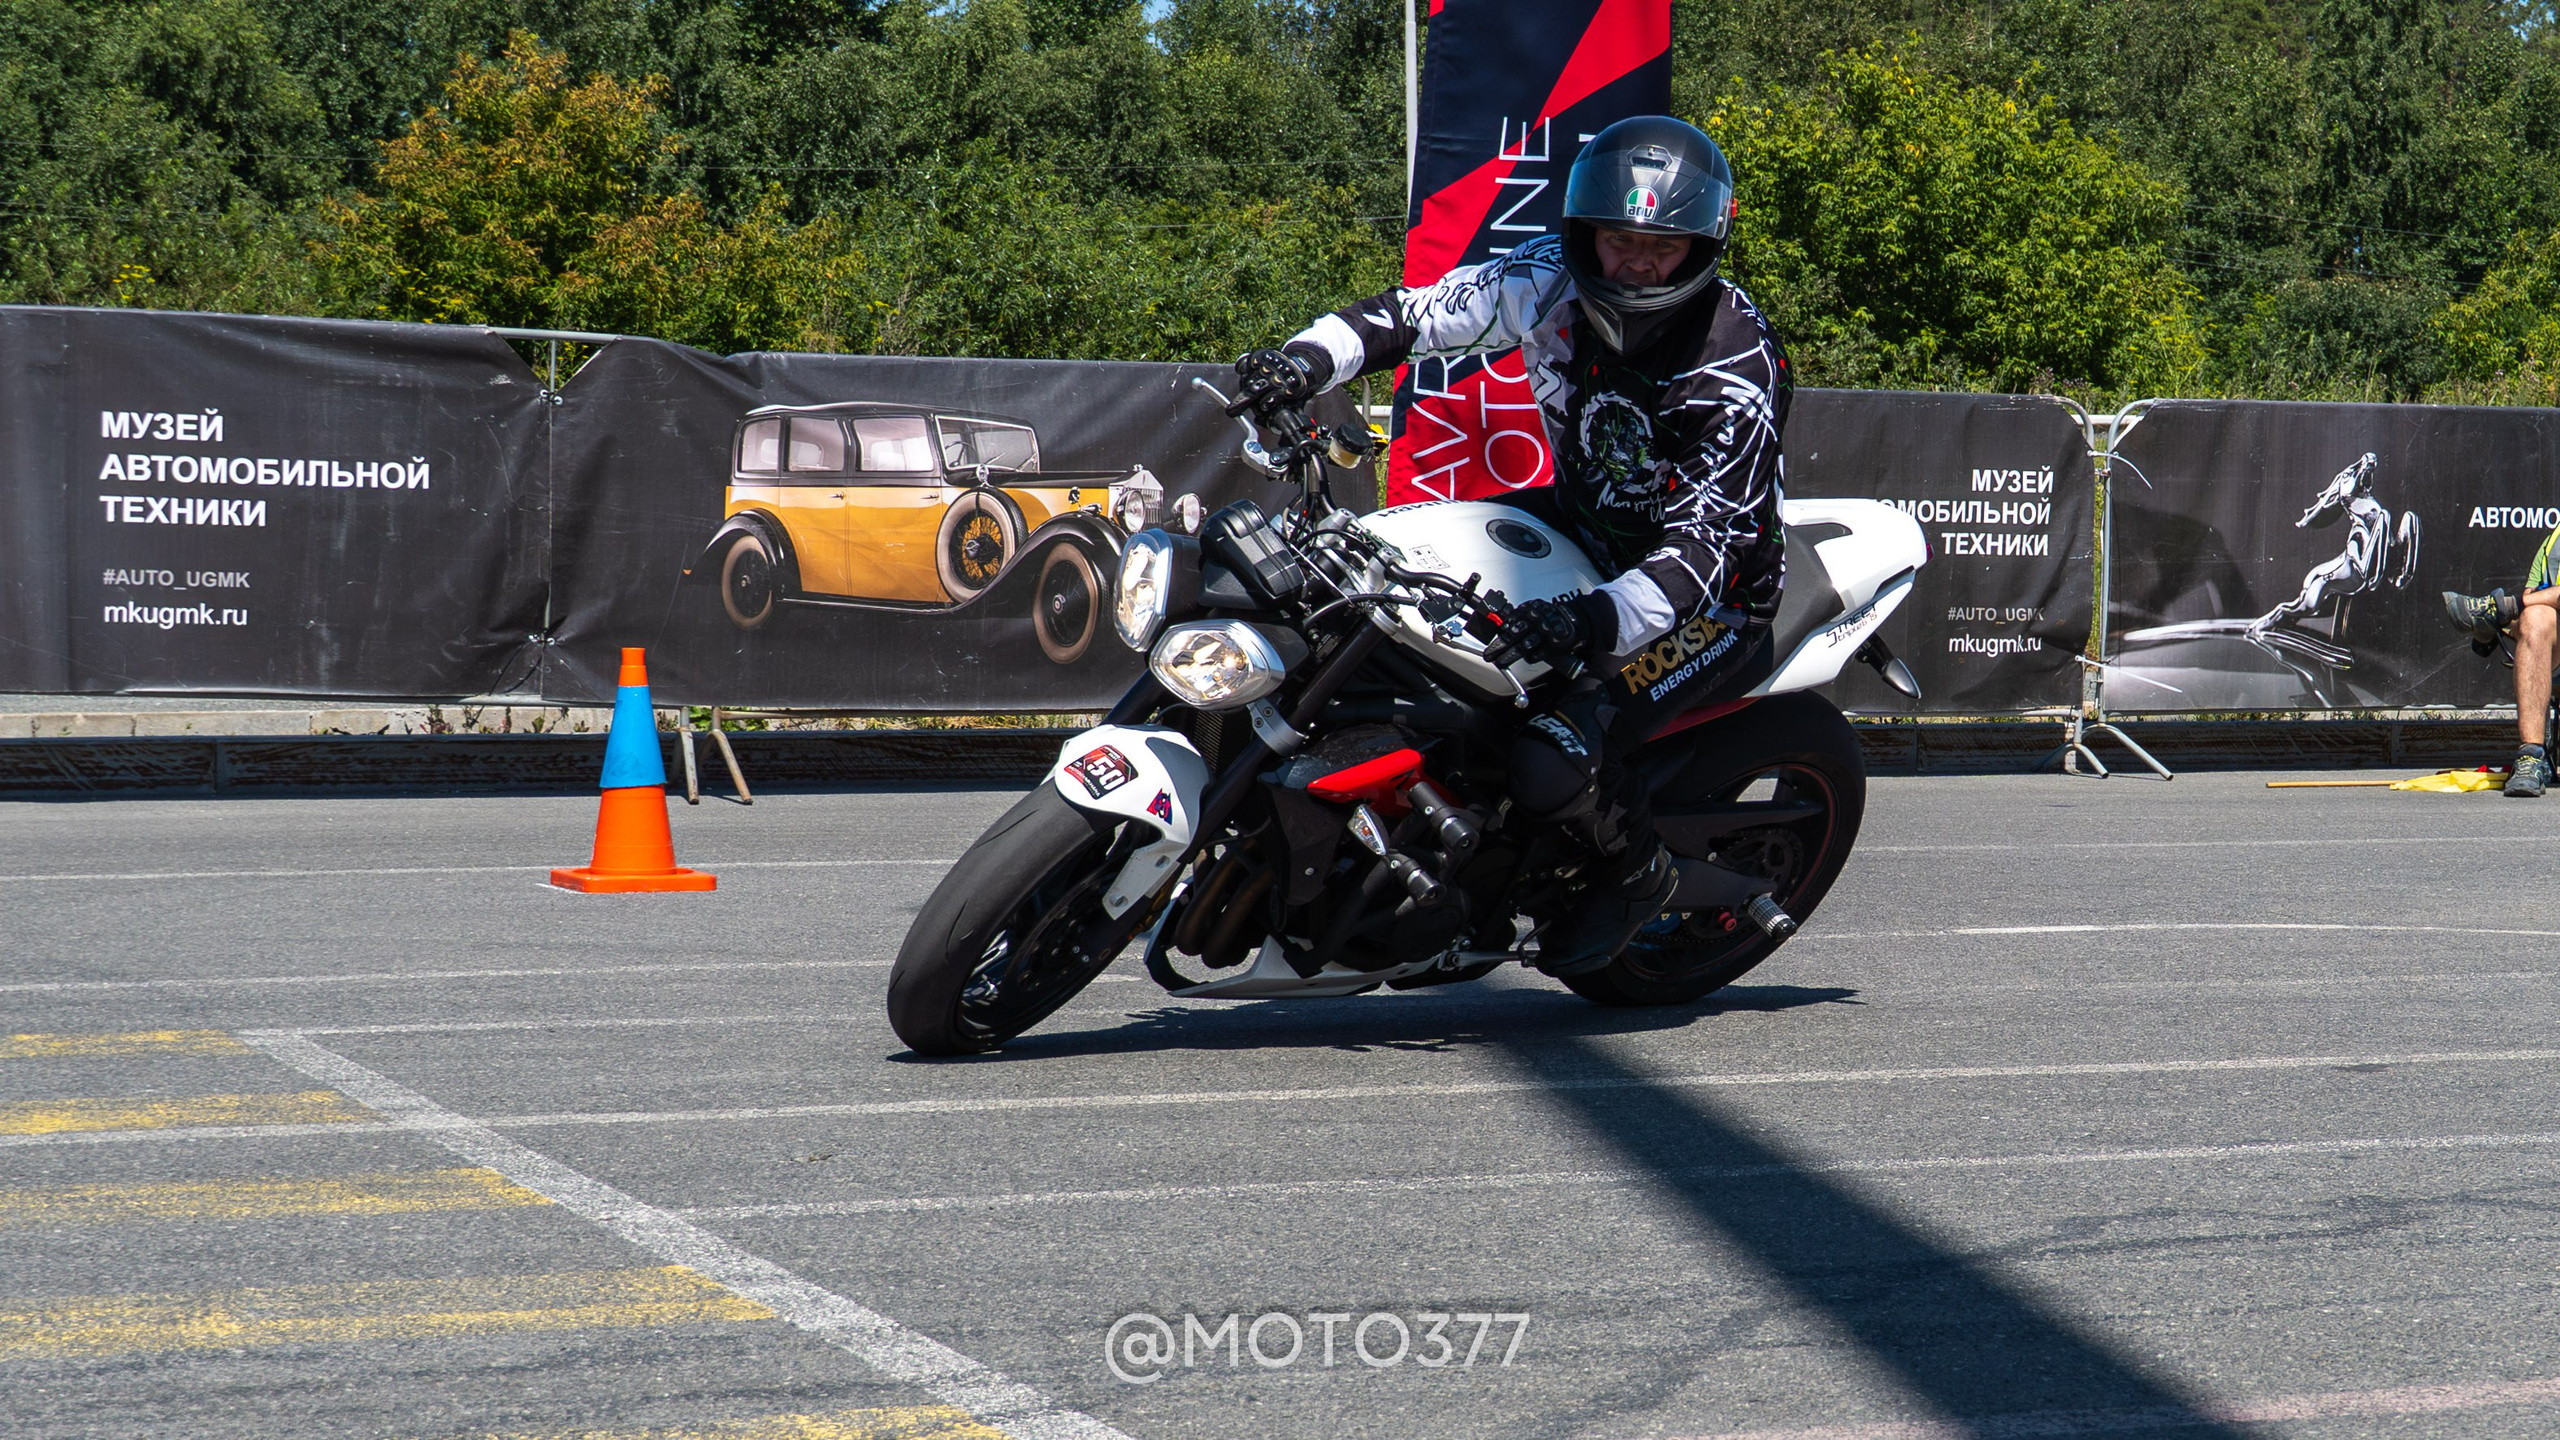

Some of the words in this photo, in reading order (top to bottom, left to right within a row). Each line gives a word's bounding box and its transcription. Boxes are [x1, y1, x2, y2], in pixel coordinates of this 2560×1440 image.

[101, 408, 224, 442] МУЗЕЙ
[99, 454, 430, 489] АВТОМОБИЛЬНОЙ
[1972, 465, 2054, 493] МУЗЕЙ
[99, 496, 267, 527] ТЕХНИКИ
[2468, 506, 2560, 529] АВТОМО
[1941, 532, 2049, 556] ТЕХНИКИ
[103, 569, 250, 590] #AUTO_UGMK
[104, 601, 248, 629] mkugmk.ru
[1948, 607, 2044, 625] #AUTO_UGMK
[1949, 633, 2042, 658] mkugmk.ru
[1650, 662, 1701, 702] ENERGY
[1701, 629, 1739, 666] DRINK
[1086, 756, 1126, 791] 50
